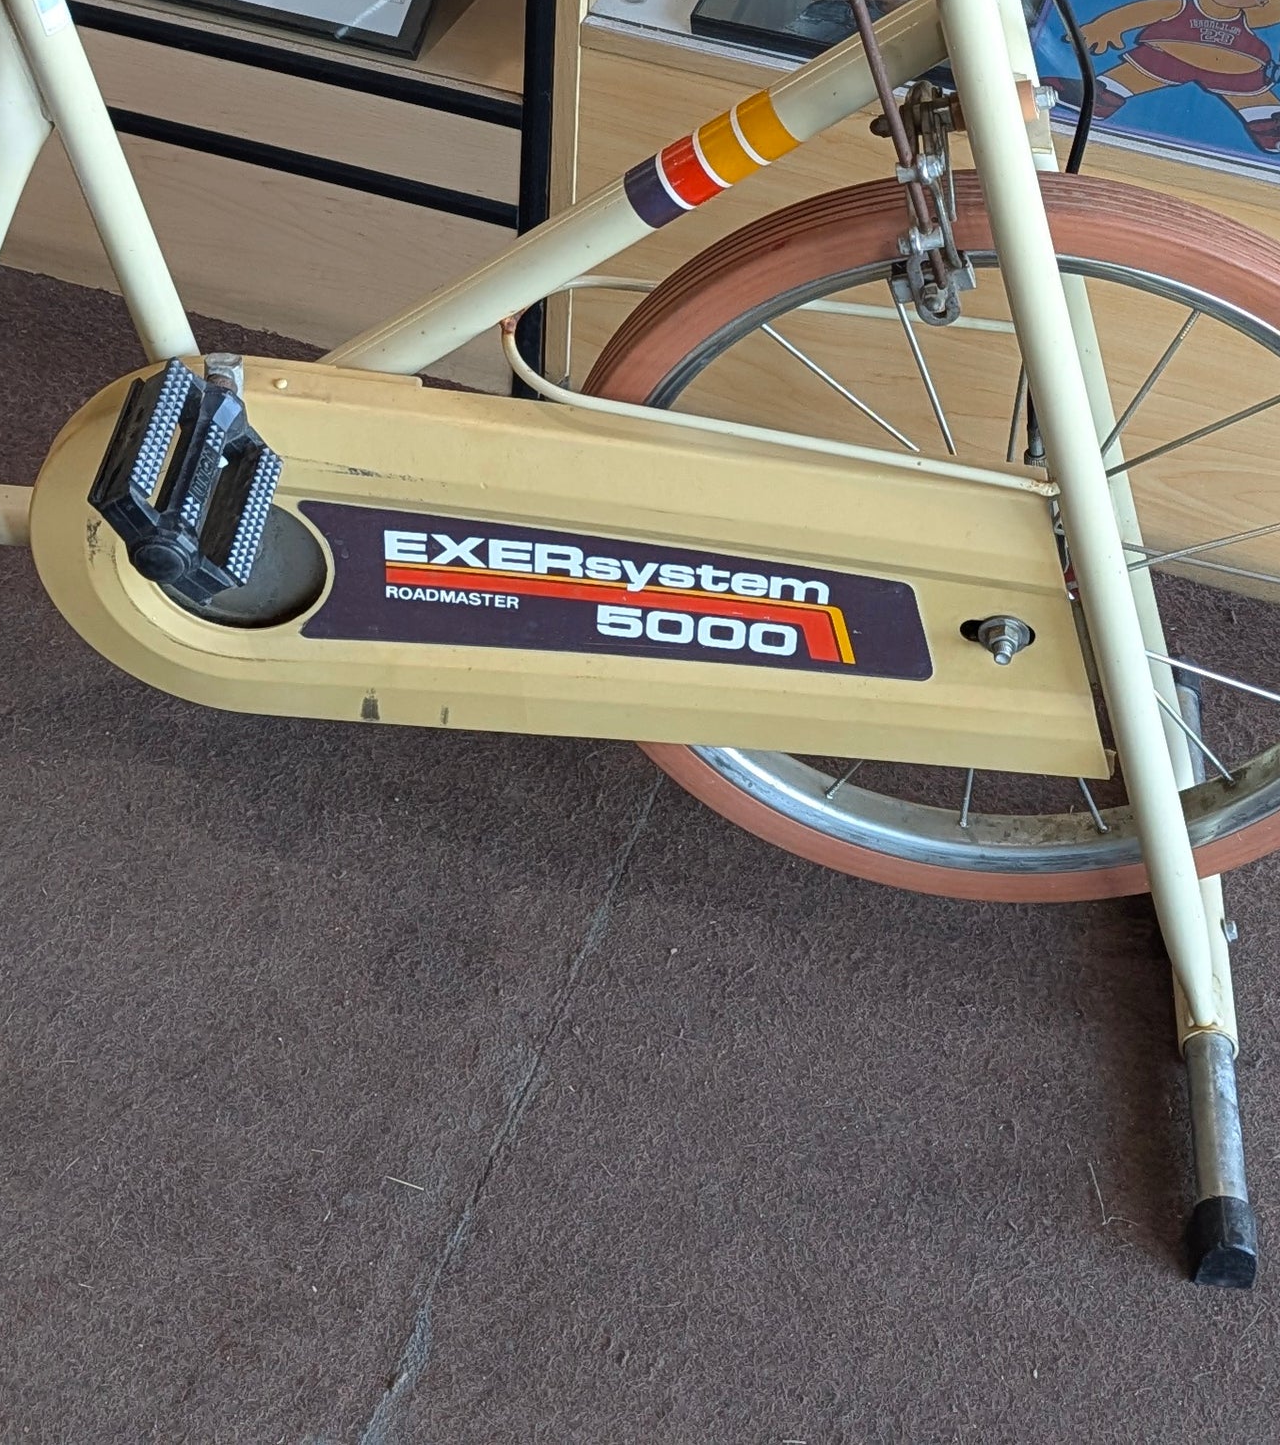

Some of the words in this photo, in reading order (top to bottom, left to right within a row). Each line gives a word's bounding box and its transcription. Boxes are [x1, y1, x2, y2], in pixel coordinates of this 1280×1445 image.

[383, 530, 830, 605] EXERsystem
[384, 584, 520, 610] ROADMASTER
[596, 603, 798, 656] 5000
